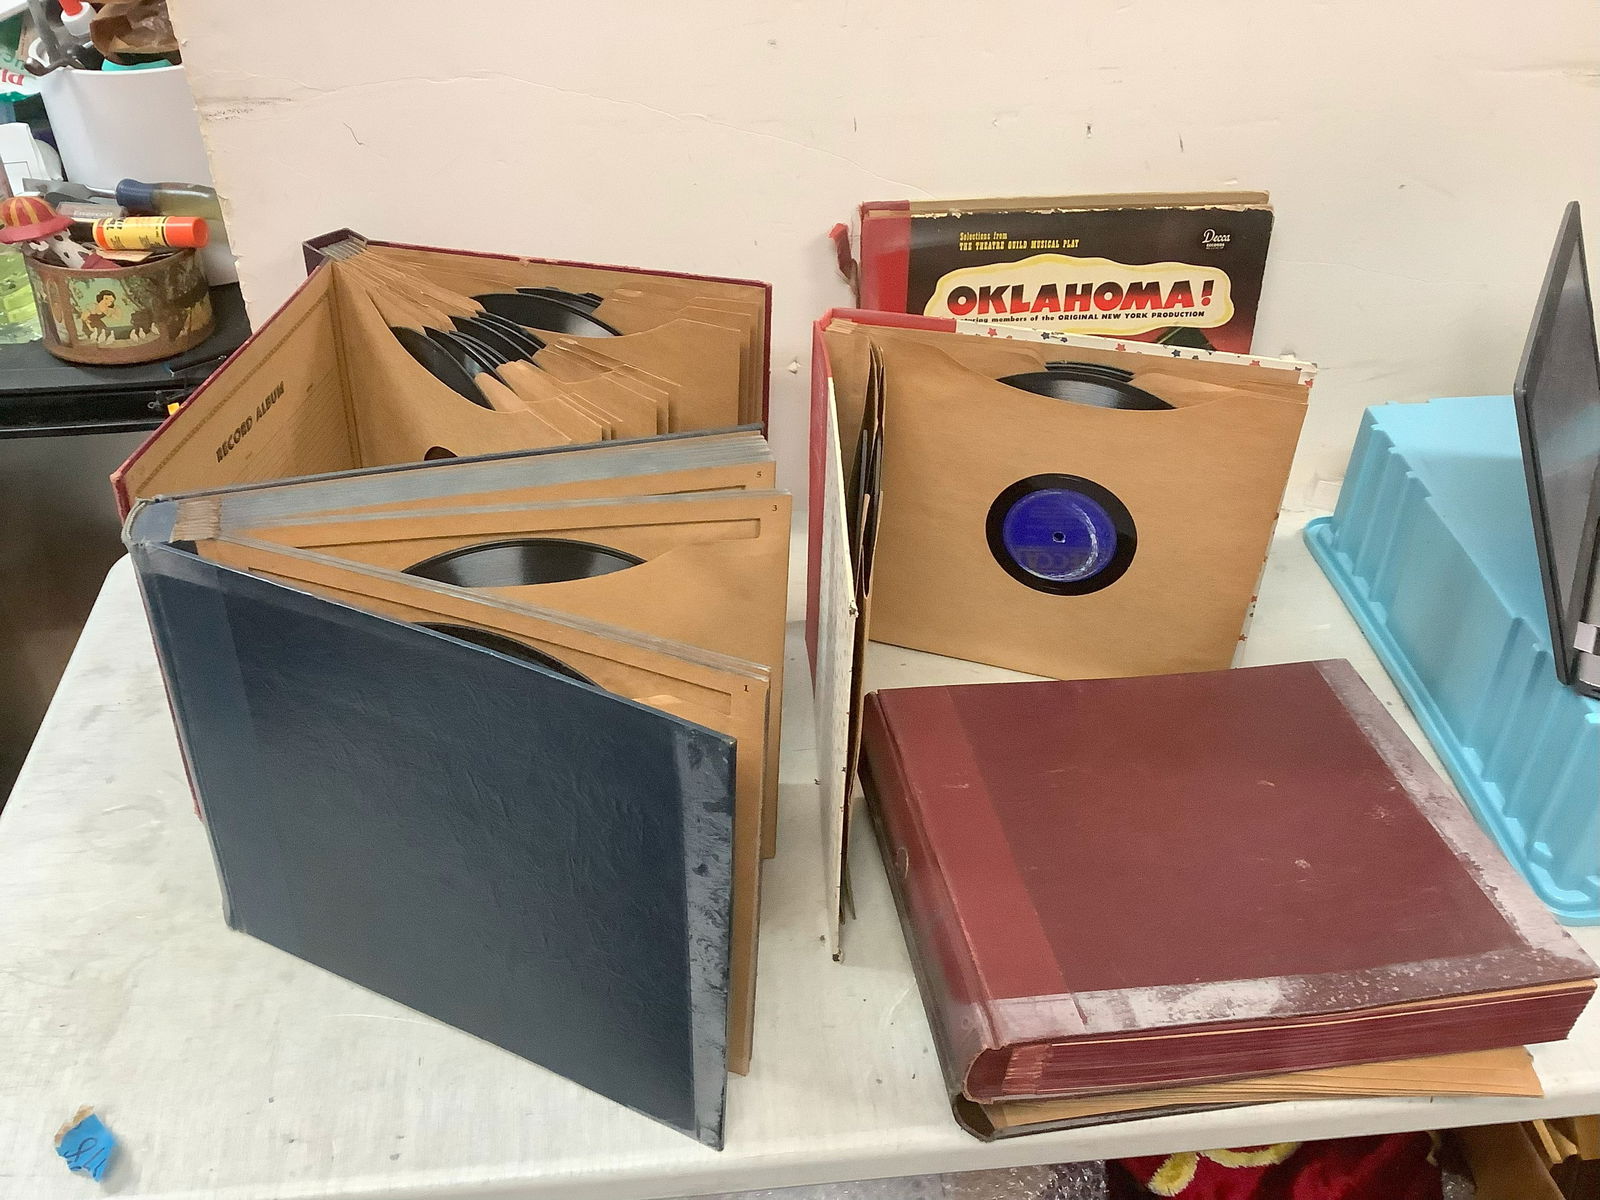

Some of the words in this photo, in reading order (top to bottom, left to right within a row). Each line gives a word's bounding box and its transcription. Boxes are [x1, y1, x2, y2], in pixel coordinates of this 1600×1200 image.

[959, 232, 990, 241] Selections
[993, 231, 1008, 240] from
[1201, 228, 1231, 244] Decca
[959, 242, 973, 251] THE
[975, 241, 1005, 250] THEATRE
[1007, 240, 1028, 250] GUILD
[1030, 239, 1060, 249] MUSICAL
[1062, 239, 1080, 248] PLAY
[946, 279, 1215, 316] OKLAHOMA!
[1058, 313, 1099, 321] ORIGINAL
[1101, 312, 1122, 320] NEW
[1151, 310, 1205, 319] PRODUCTION
[216, 415, 253, 463] RECORD
[256, 380, 285, 422] ALBUM
[755, 470, 762, 479] 5
[771, 504, 778, 512] 3
